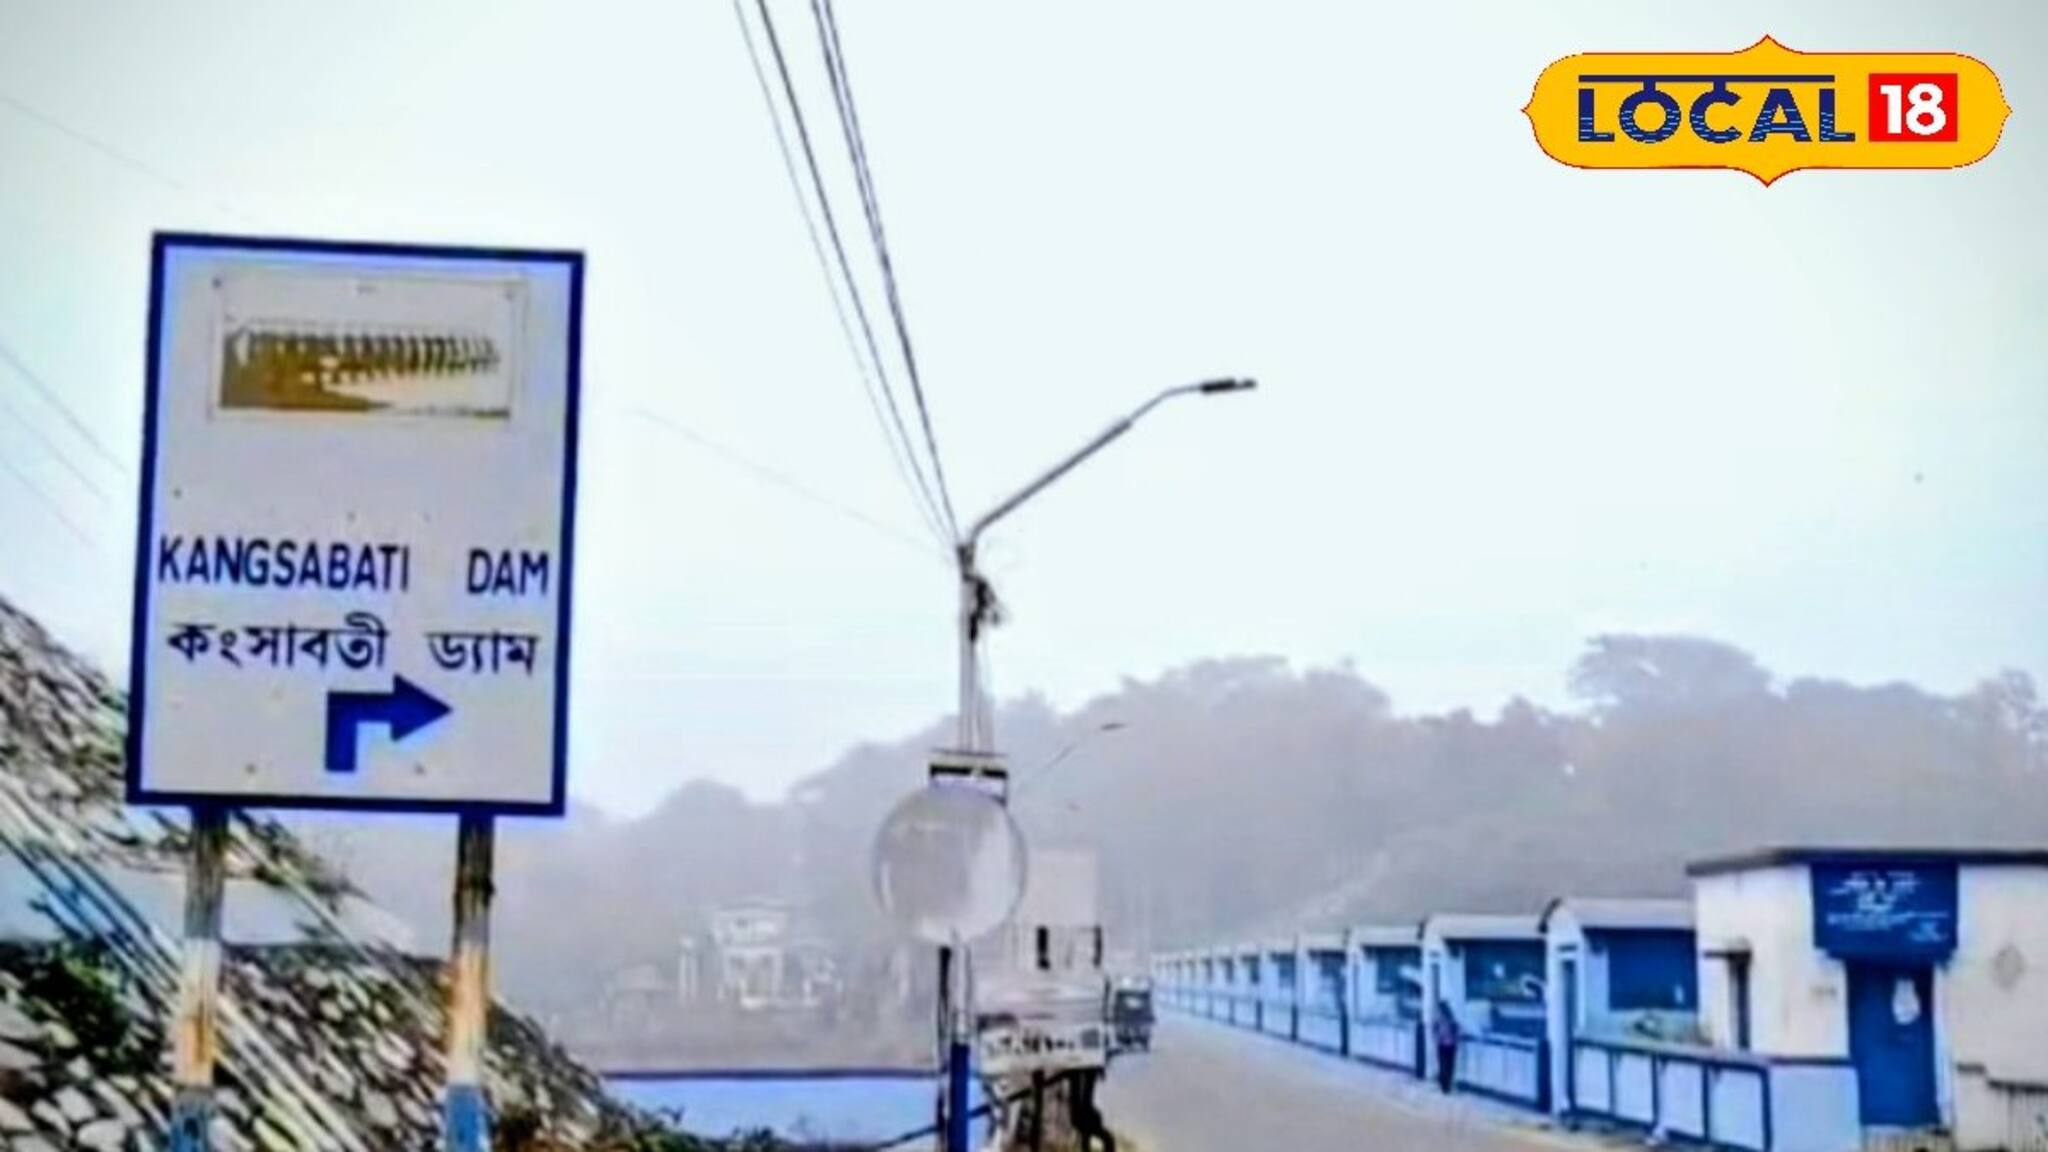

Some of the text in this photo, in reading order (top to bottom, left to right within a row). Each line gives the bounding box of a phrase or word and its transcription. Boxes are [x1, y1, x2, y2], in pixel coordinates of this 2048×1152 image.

[158, 534, 549, 596] KANGSABATI DAM
[167, 611, 541, 677] কংসাবতী ড্যাম
